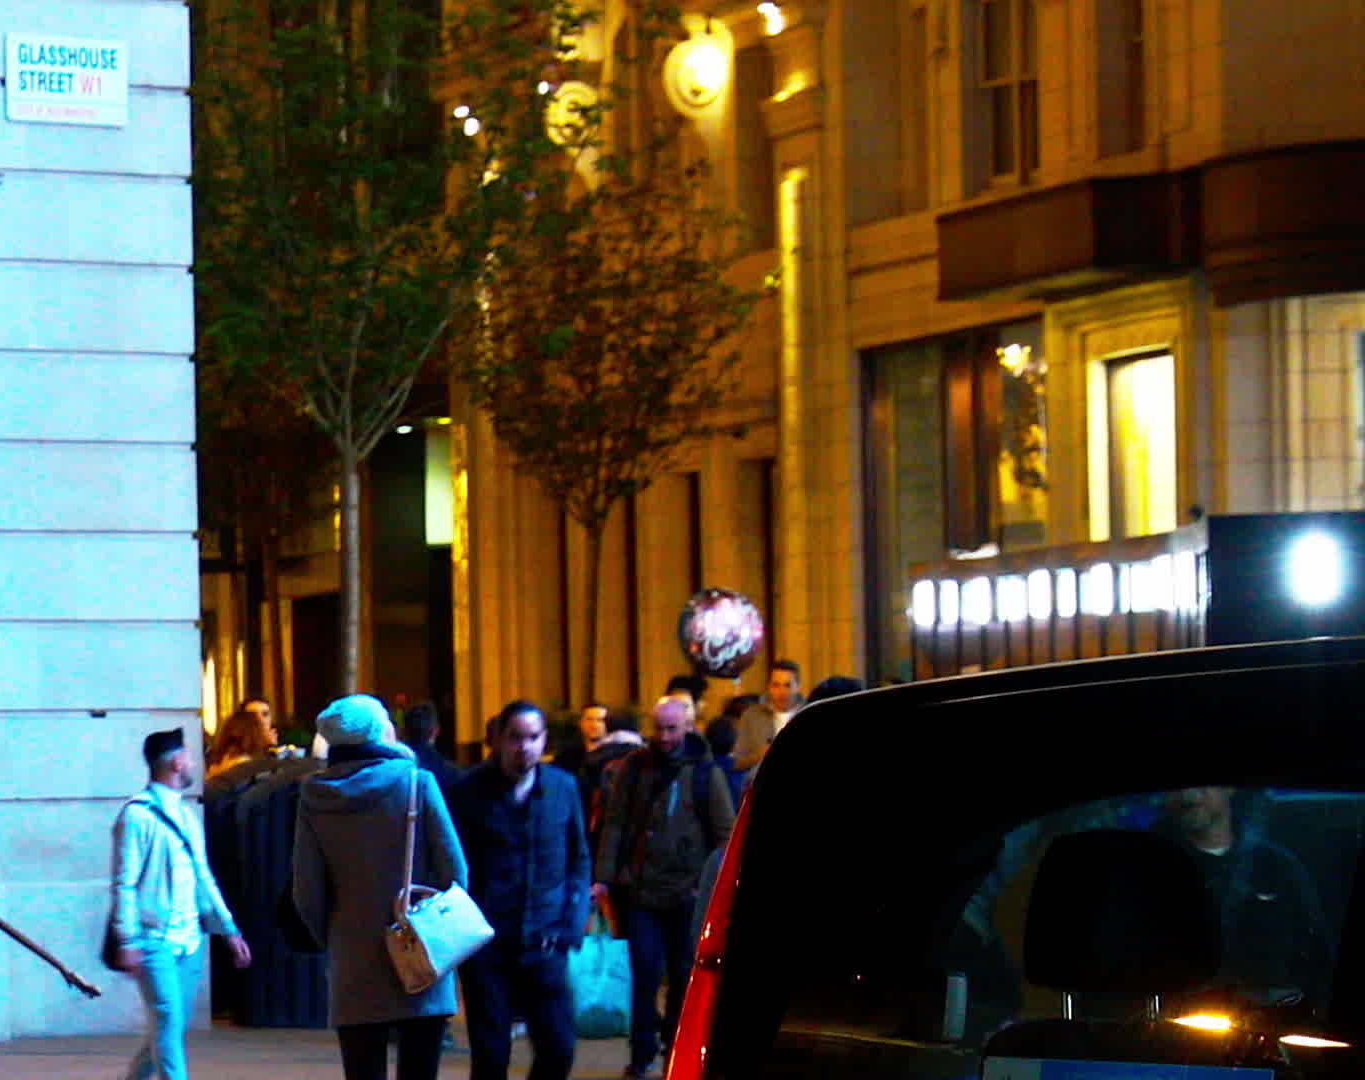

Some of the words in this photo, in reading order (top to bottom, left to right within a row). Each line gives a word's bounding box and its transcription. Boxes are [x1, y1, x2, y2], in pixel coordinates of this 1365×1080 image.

[17, 42, 118, 71] GLASSHOUSE
[18, 69, 75, 94] STREET
[80, 74, 102, 96] W1
